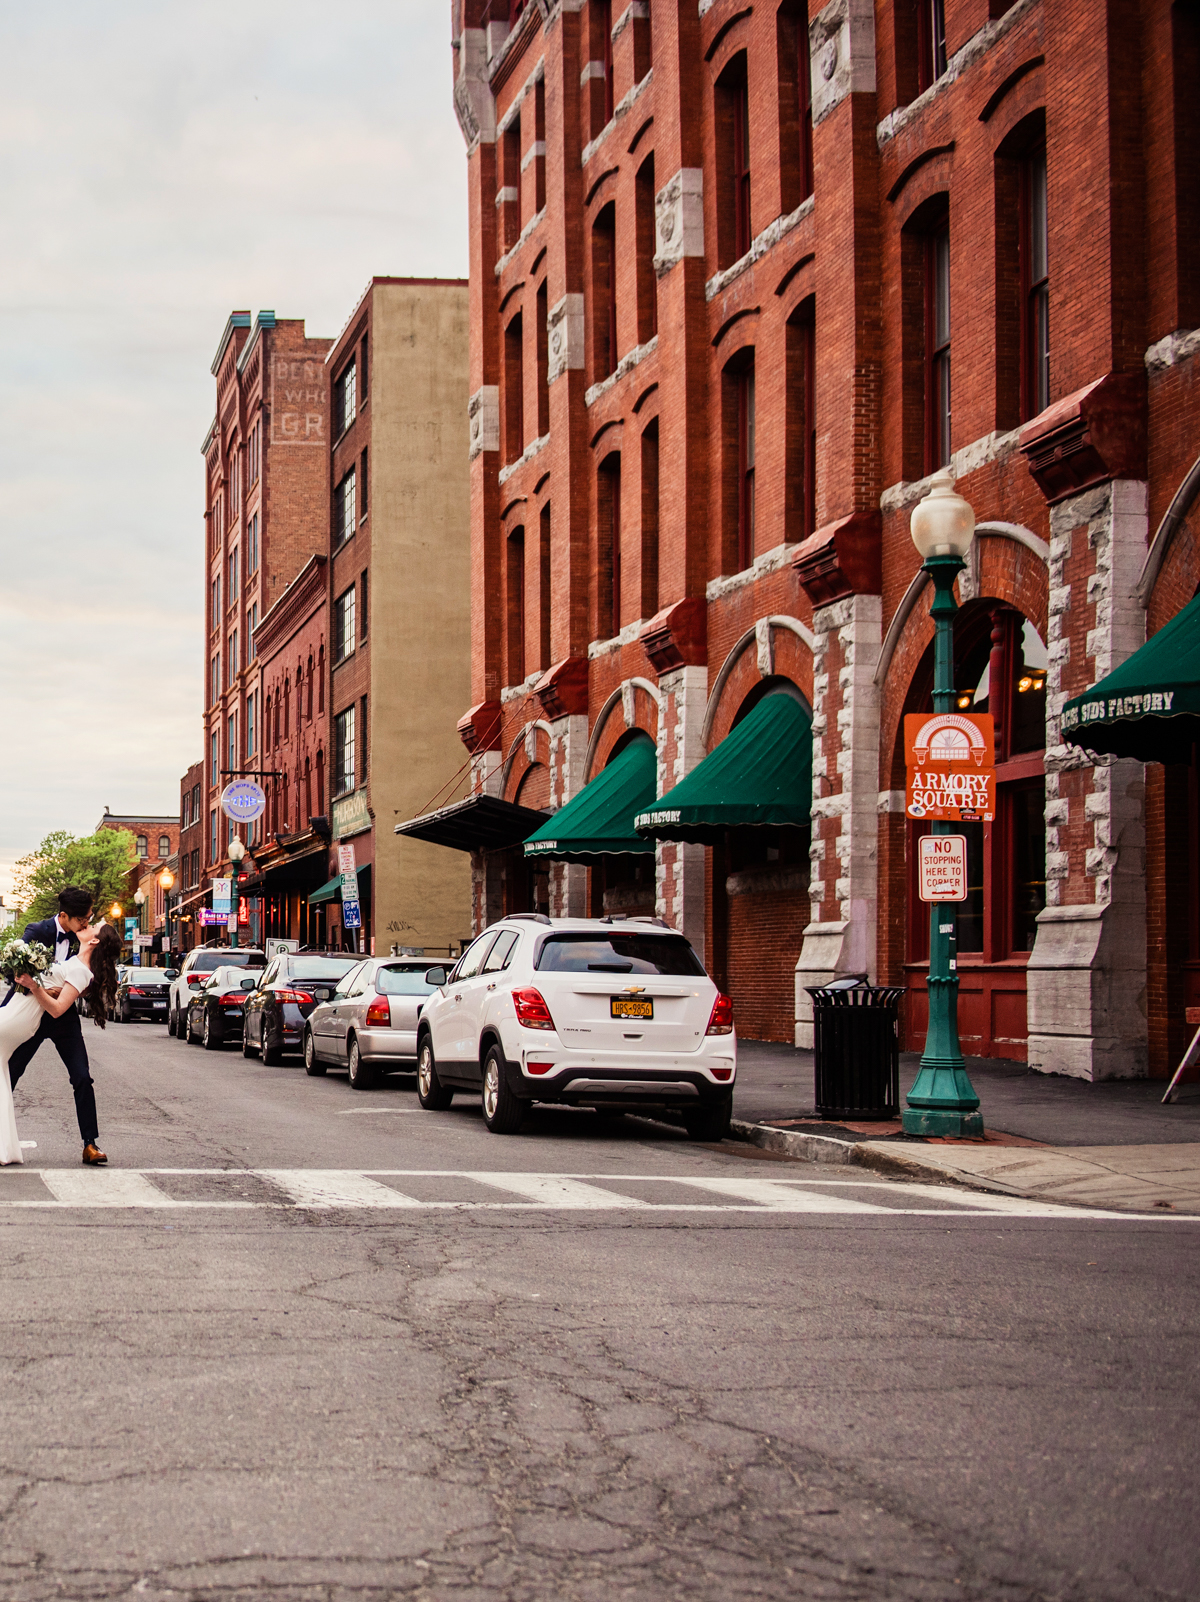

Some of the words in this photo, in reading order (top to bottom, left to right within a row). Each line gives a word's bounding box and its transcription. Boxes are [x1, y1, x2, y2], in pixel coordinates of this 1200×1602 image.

[1108, 691, 1174, 717] FACTORY
[911, 772, 991, 792] ARMORY
[912, 790, 989, 810] SQUARE
[651, 810, 681, 824] FACTORY
[934, 841, 952, 853] NO
[924, 856, 962, 865] STOPPING
[926, 867, 948, 876] HERE
[951, 867, 962, 876] TO
[927, 878, 960, 887] CORNER
